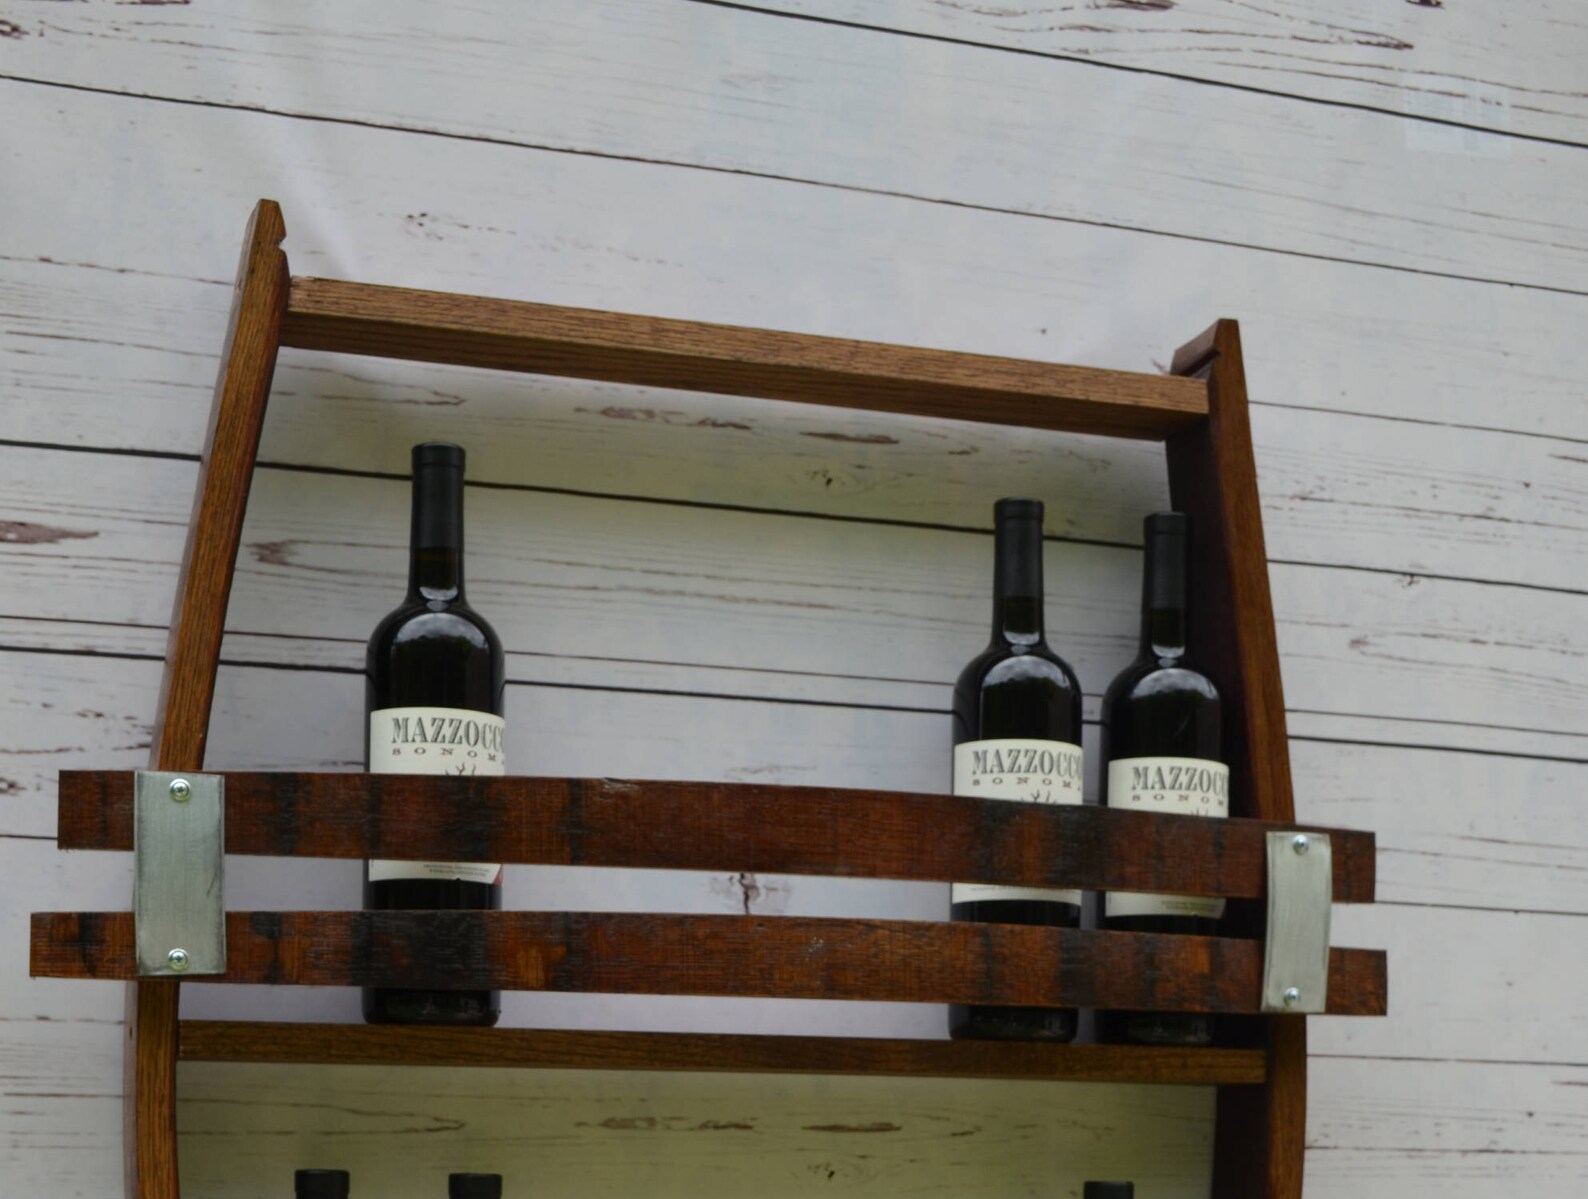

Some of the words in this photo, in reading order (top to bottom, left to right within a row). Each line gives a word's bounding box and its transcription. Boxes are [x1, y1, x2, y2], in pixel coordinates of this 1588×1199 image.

[391, 716, 505, 753] MAZZOCC
[392, 746, 505, 765] SONOM
[972, 776, 1082, 792] SONOM
